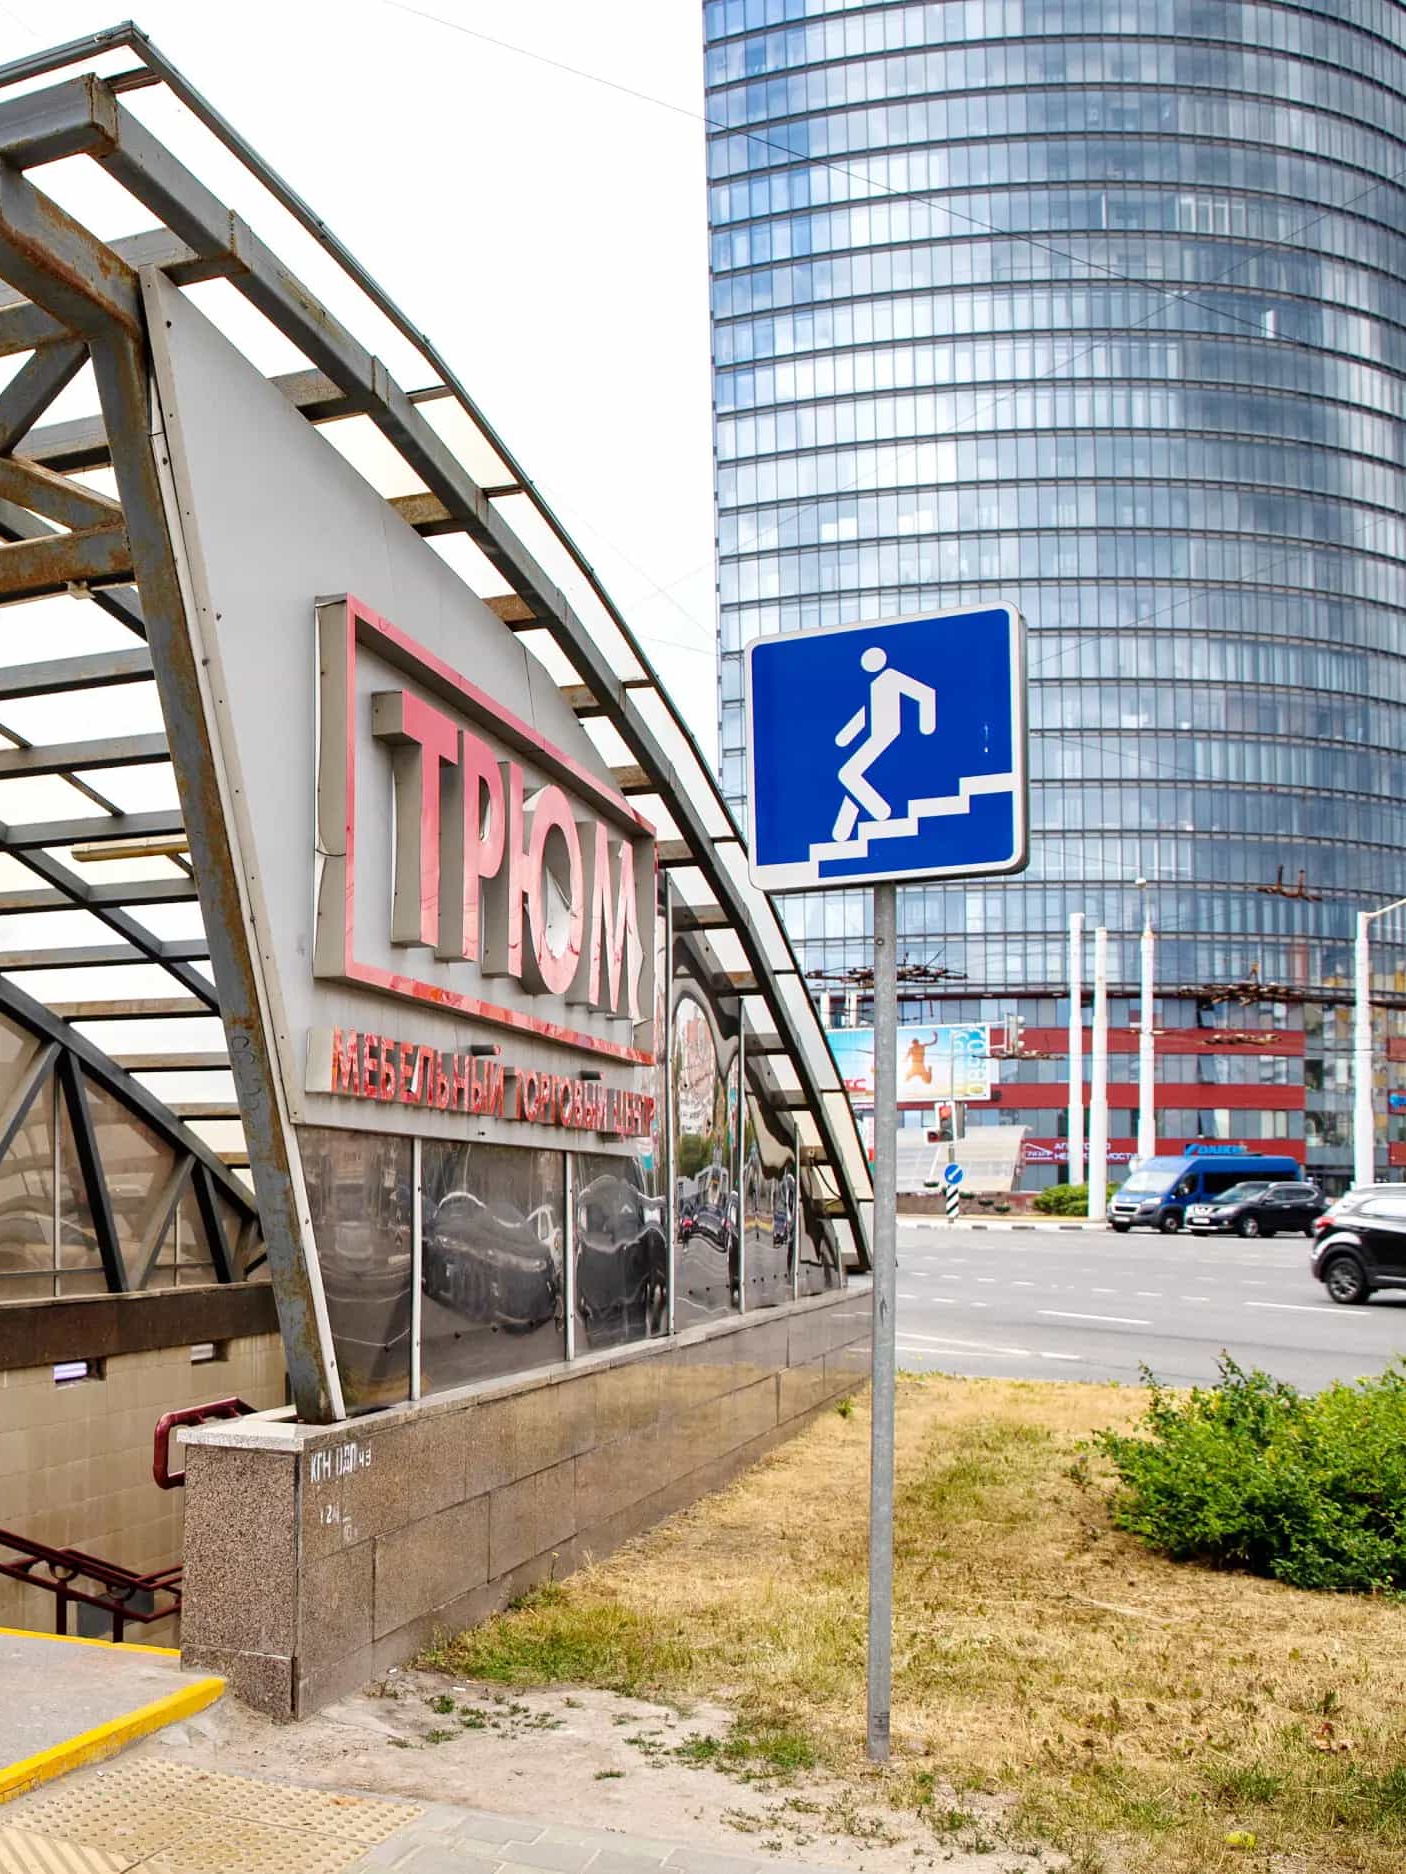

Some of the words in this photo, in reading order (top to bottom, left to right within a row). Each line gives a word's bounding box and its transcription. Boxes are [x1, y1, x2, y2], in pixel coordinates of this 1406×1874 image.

[397, 687, 643, 1020] ТРЮМ
[330, 1024, 505, 1118] МЕБЕЛЬНЫЙ
[513, 1068, 608, 1131] ТОРГОВЫЙ
[612, 1089, 657, 1143] ЦЕНТР
